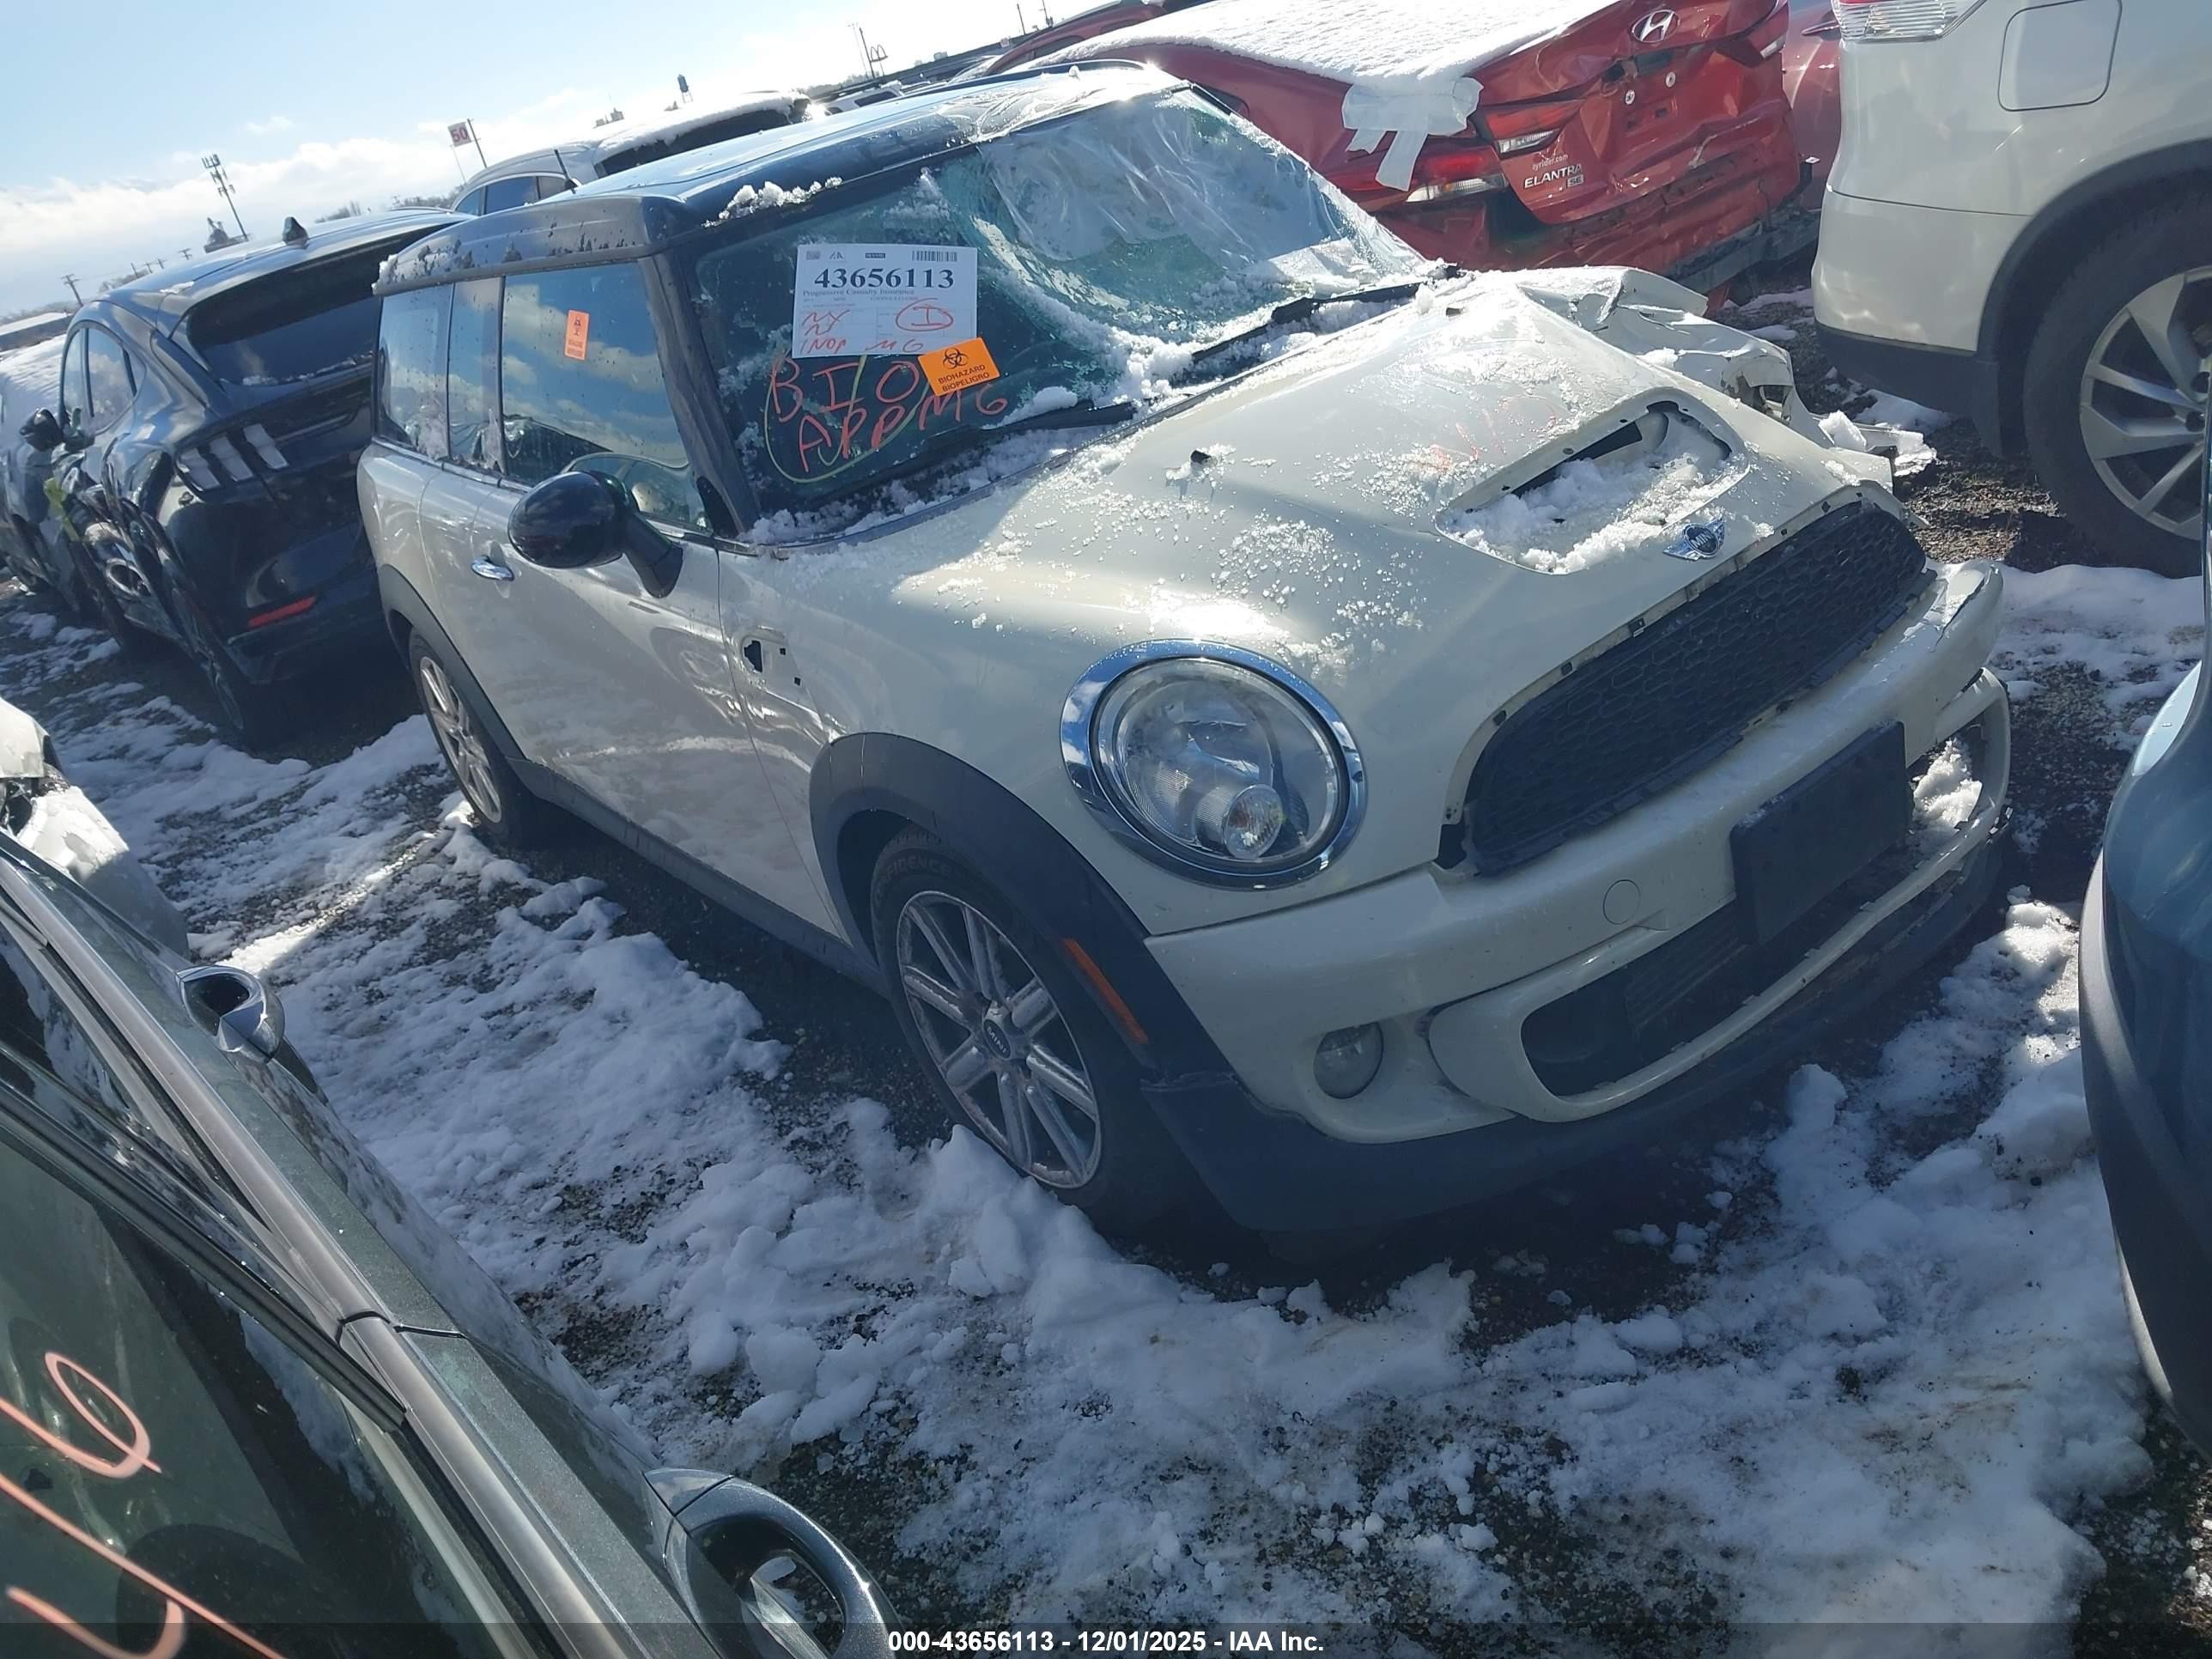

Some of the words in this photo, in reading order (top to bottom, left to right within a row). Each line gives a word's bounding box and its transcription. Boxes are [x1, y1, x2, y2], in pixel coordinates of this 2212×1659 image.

[450, 127, 468, 143] 50
[1524, 163, 1582, 188] ELANTRA
[814, 267, 955, 289] 43656113
[938, 364, 986, 385] BIOHAZARD
[942, 372, 990, 392] BIOPELIGRO
[772, 354, 920, 422] BIO
[987, 1026, 1007, 1054] MINI
